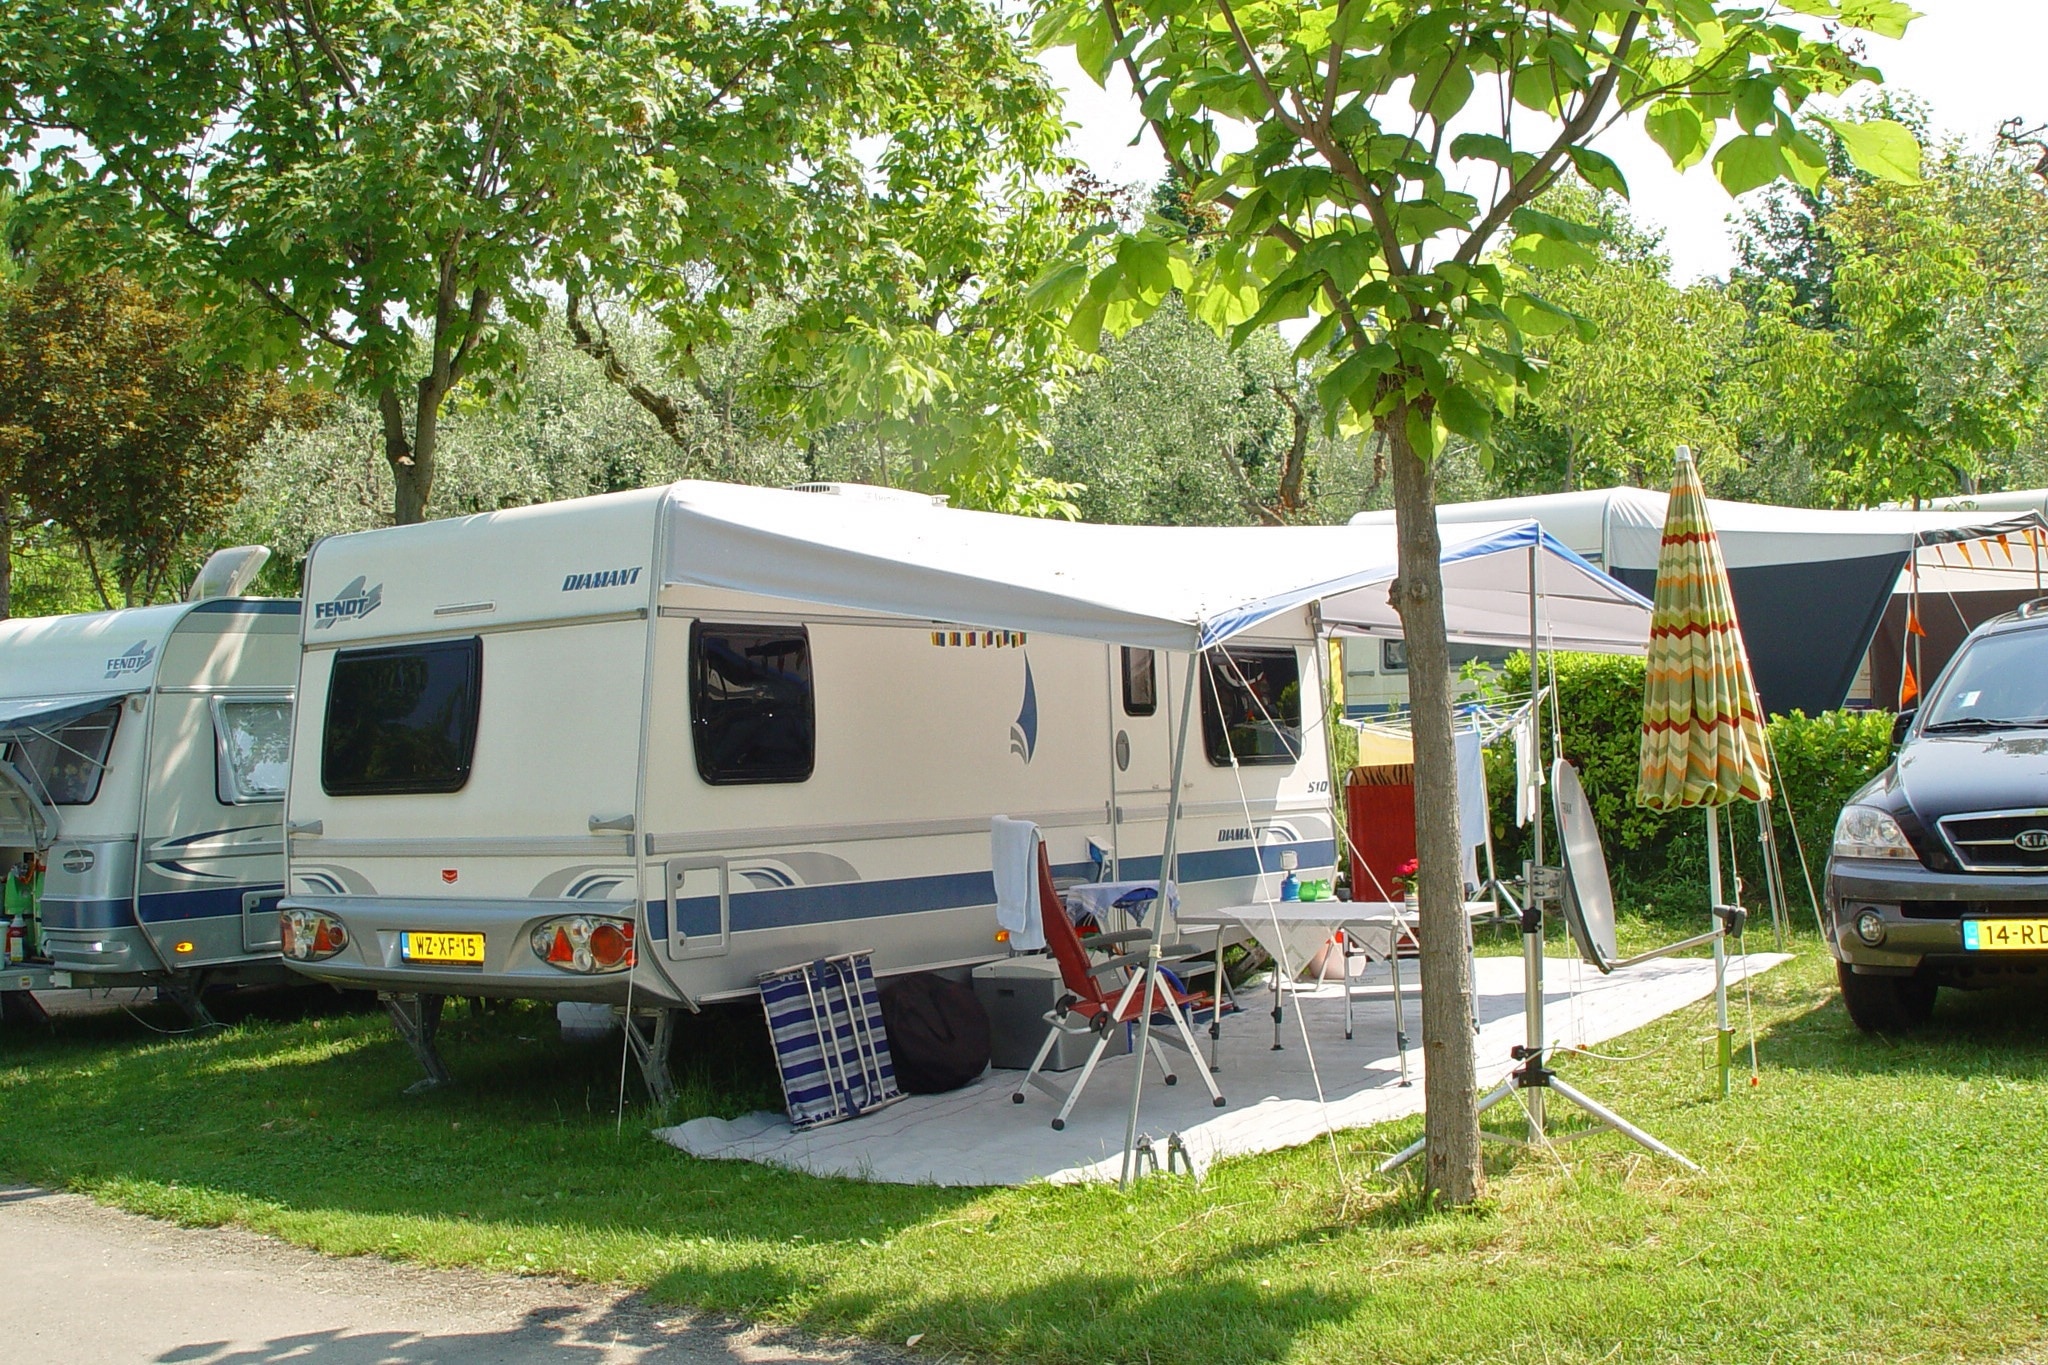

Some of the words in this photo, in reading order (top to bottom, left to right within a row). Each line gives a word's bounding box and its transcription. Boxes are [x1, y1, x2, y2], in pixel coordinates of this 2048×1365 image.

[562, 566, 643, 592] DIAMANT
[315, 598, 369, 619] FENDT
[107, 657, 145, 670] FENDT
[2021, 834, 2048, 847] KIA
[416, 936, 476, 957] WZ-XF-15
